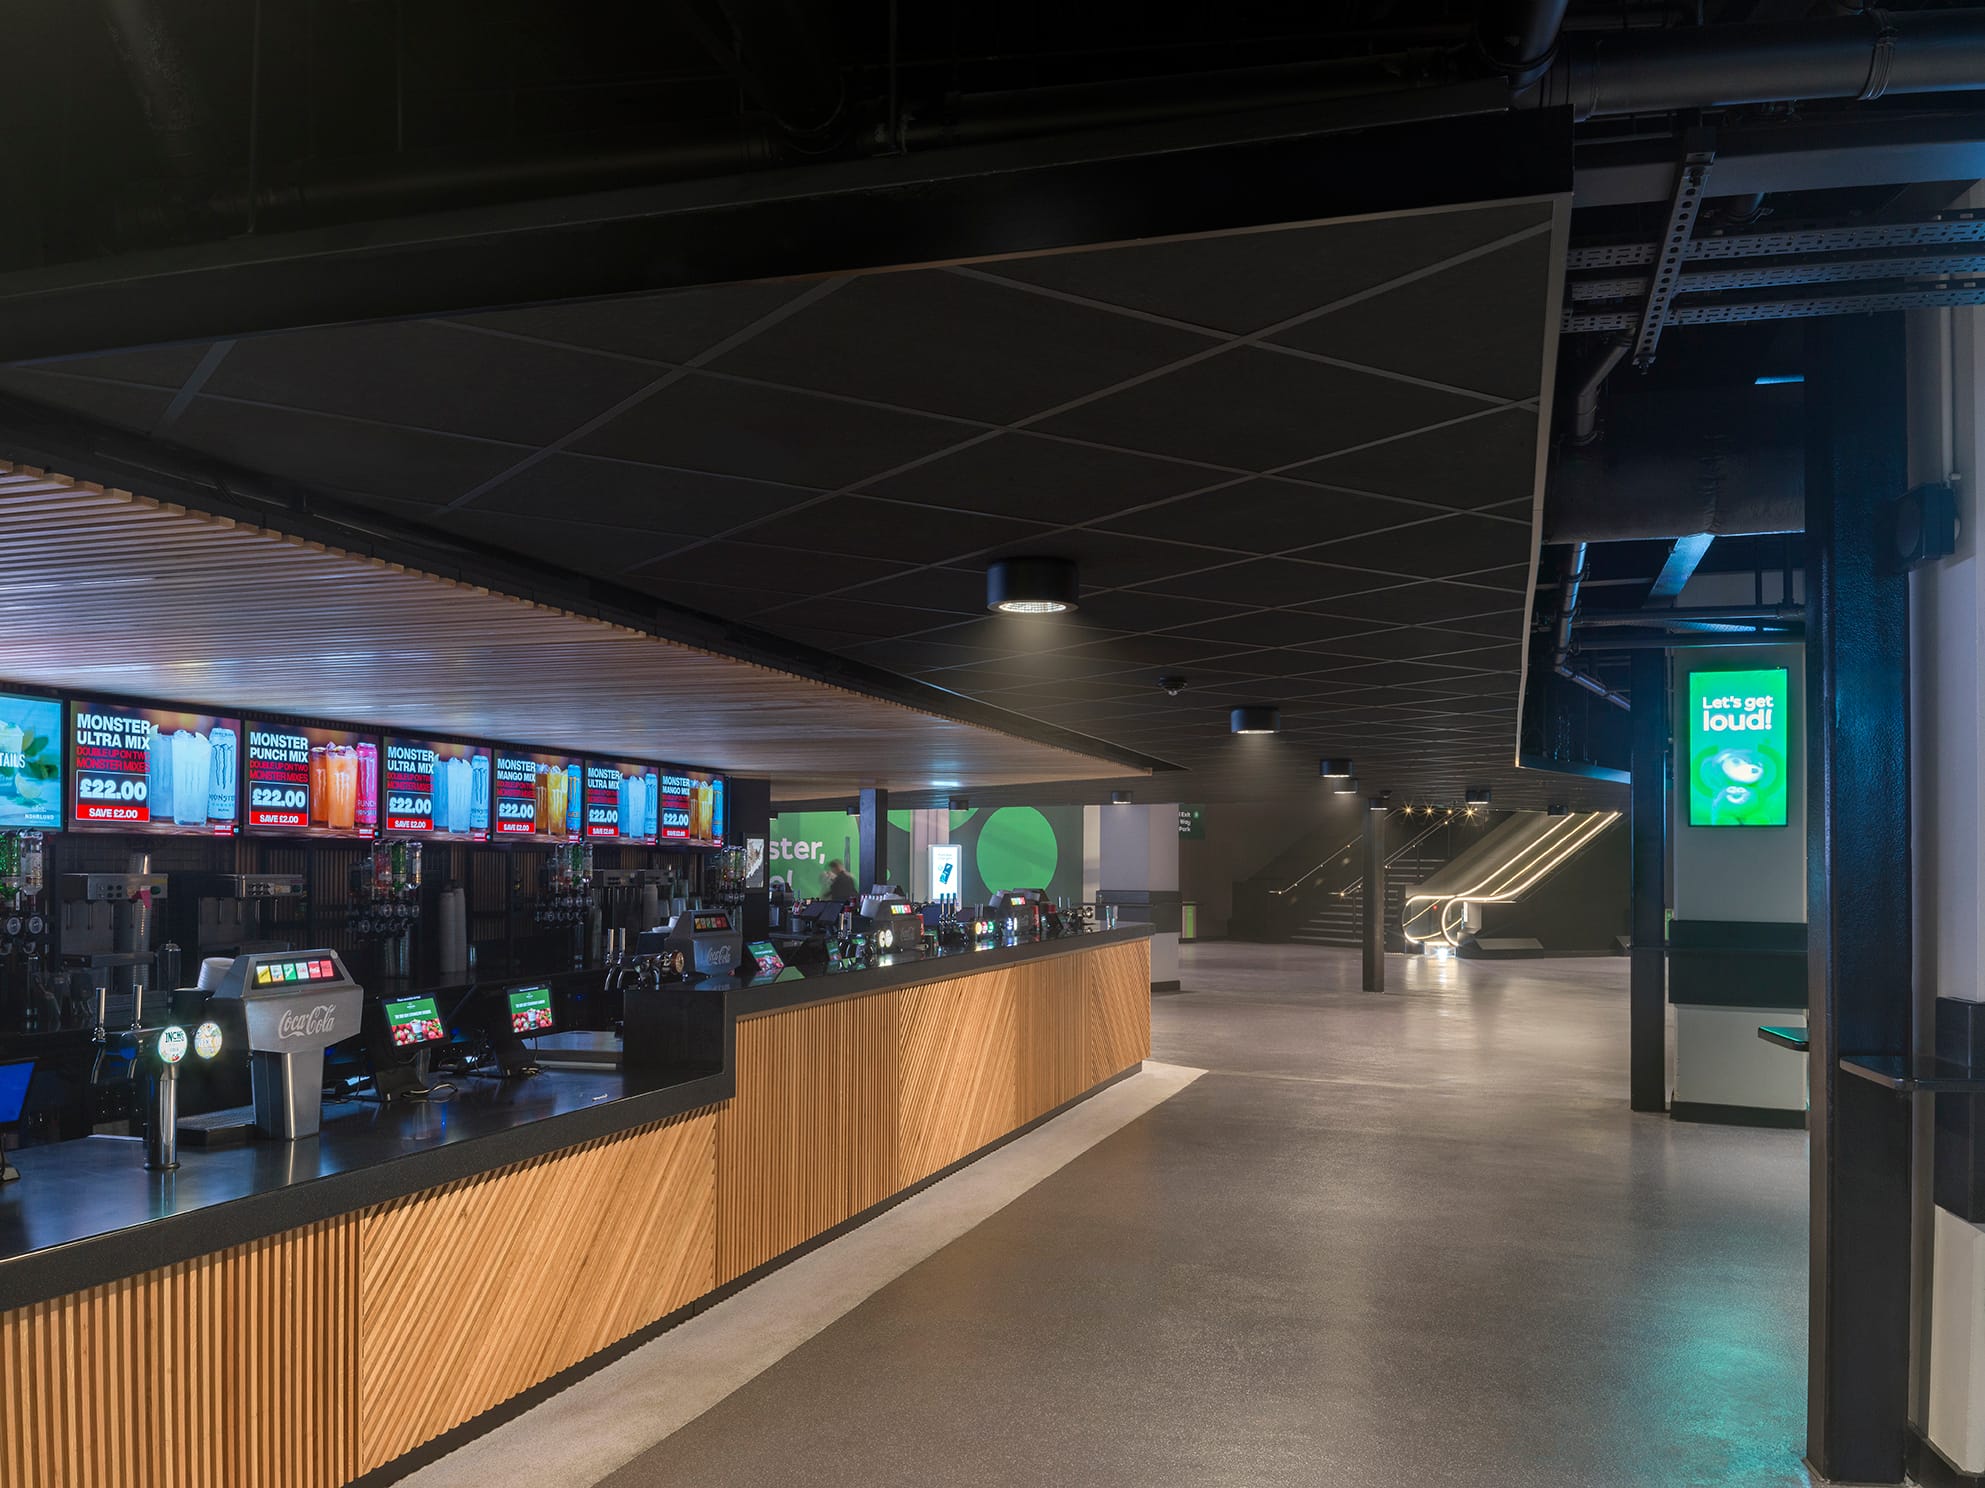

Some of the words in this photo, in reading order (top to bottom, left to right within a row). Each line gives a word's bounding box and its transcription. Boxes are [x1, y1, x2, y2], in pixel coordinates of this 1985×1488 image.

[1702, 696, 1742, 709] Let's
[1744, 695, 1774, 712] get
[77, 713, 151, 735] MONSTER
[1703, 709, 1773, 732] loud!
[77, 730, 122, 748] ULTRA
[125, 735, 151, 750] MIX
[250, 731, 309, 750] MONSTER
[76, 746, 109, 757] DOUBLE
[120, 750, 132, 759] ON
[250, 747, 287, 761] PUNCH
[289, 750, 309, 763] MIX
[387, 746, 434, 762] MONSTER
[76, 757, 123, 771] MONSTER
[124, 761, 151, 773] MIXES
[387, 760, 416, 773] ULTRA
[418, 762, 434, 775] MIX
[497, 758, 536, 772] MONSTER
[497, 770, 523, 781] MANGO
[523, 773, 536, 783] MIX
[587, 767, 620, 780] MONSTER
[662, 775, 690, 787] MONSTER
[80, 778, 147, 800] £22.00
[587, 778, 608, 789] ULTRA
[608, 780, 620, 790] MIX
[252, 788, 306, 808] £22.00
[389, 797, 432, 815] £22.00
[89, 808, 112, 818] SAVE
[114, 810, 138, 819] £2.00
[259, 814, 278, 823] SAVE
[279, 815, 299, 824] £2.00
[499, 803, 534, 819] £22.00
[589, 809, 618, 823] £22.00
[663, 812, 689, 826] £22.00
[394, 820, 409, 828] SAVE
[278, 1004, 336, 1039] Coca-Cola
